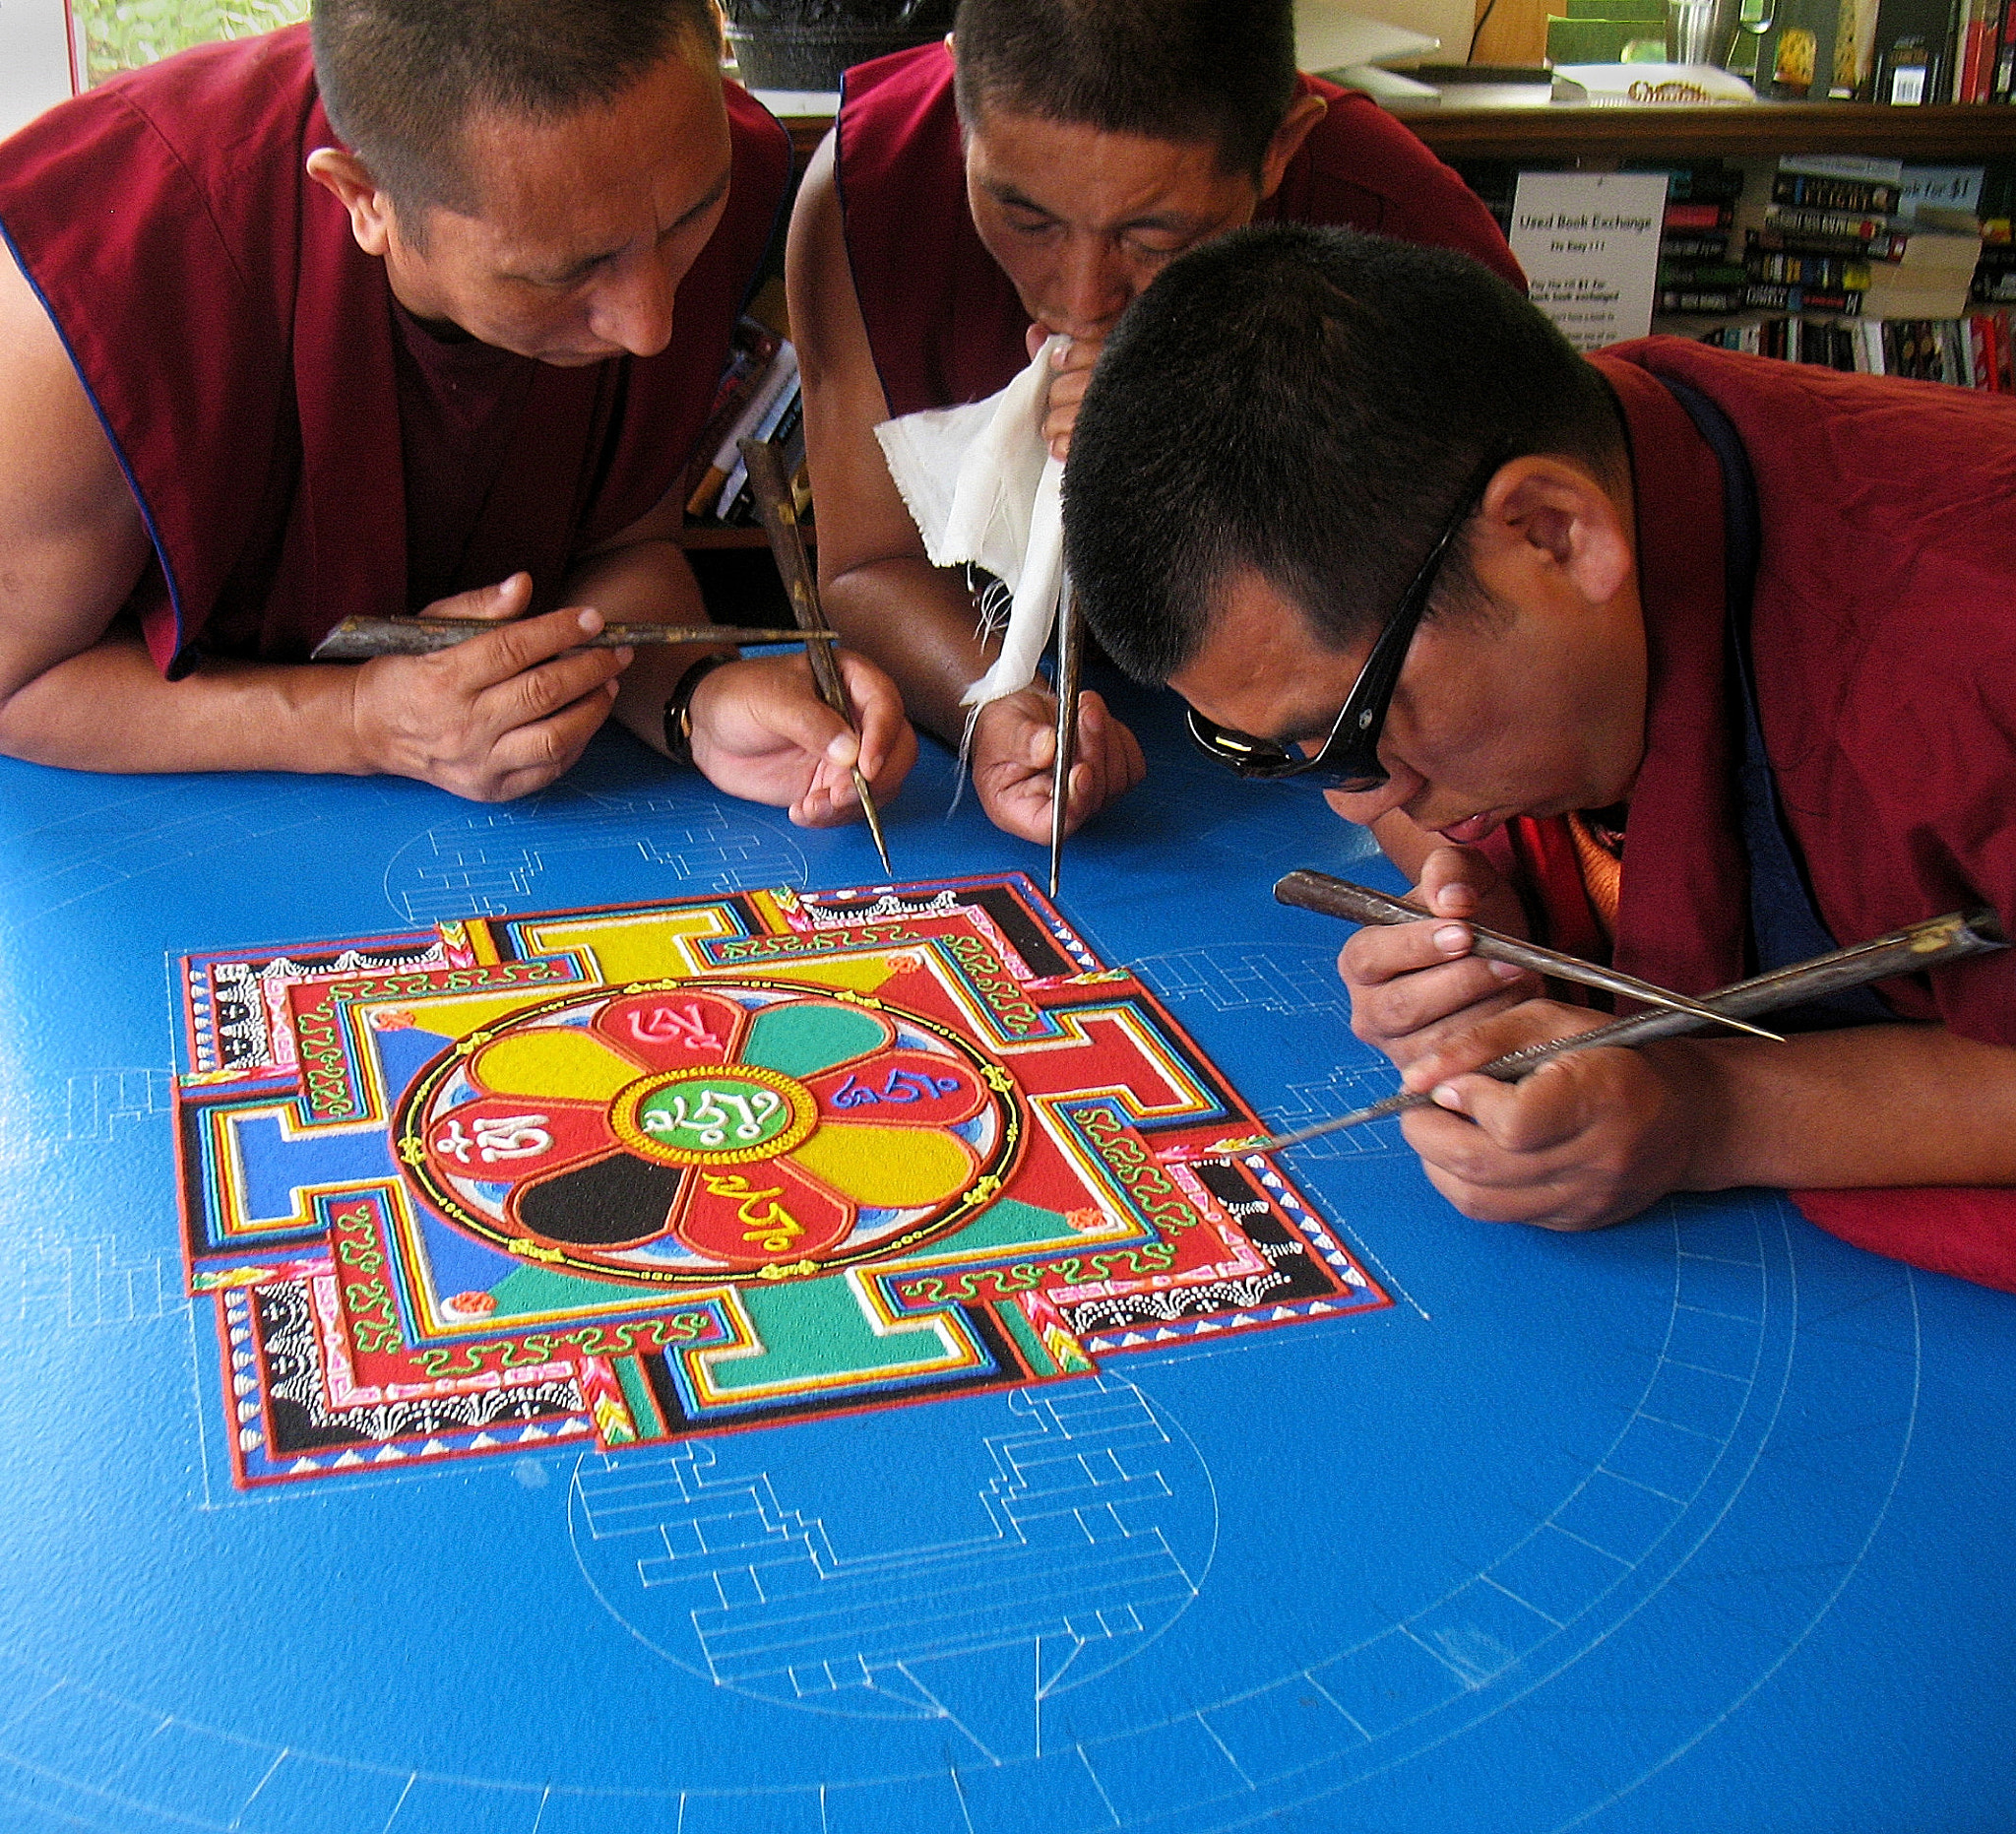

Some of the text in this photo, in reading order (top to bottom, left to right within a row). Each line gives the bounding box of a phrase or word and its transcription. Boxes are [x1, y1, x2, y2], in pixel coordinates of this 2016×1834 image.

[1520, 214, 1652, 232] Used Book Exchange
